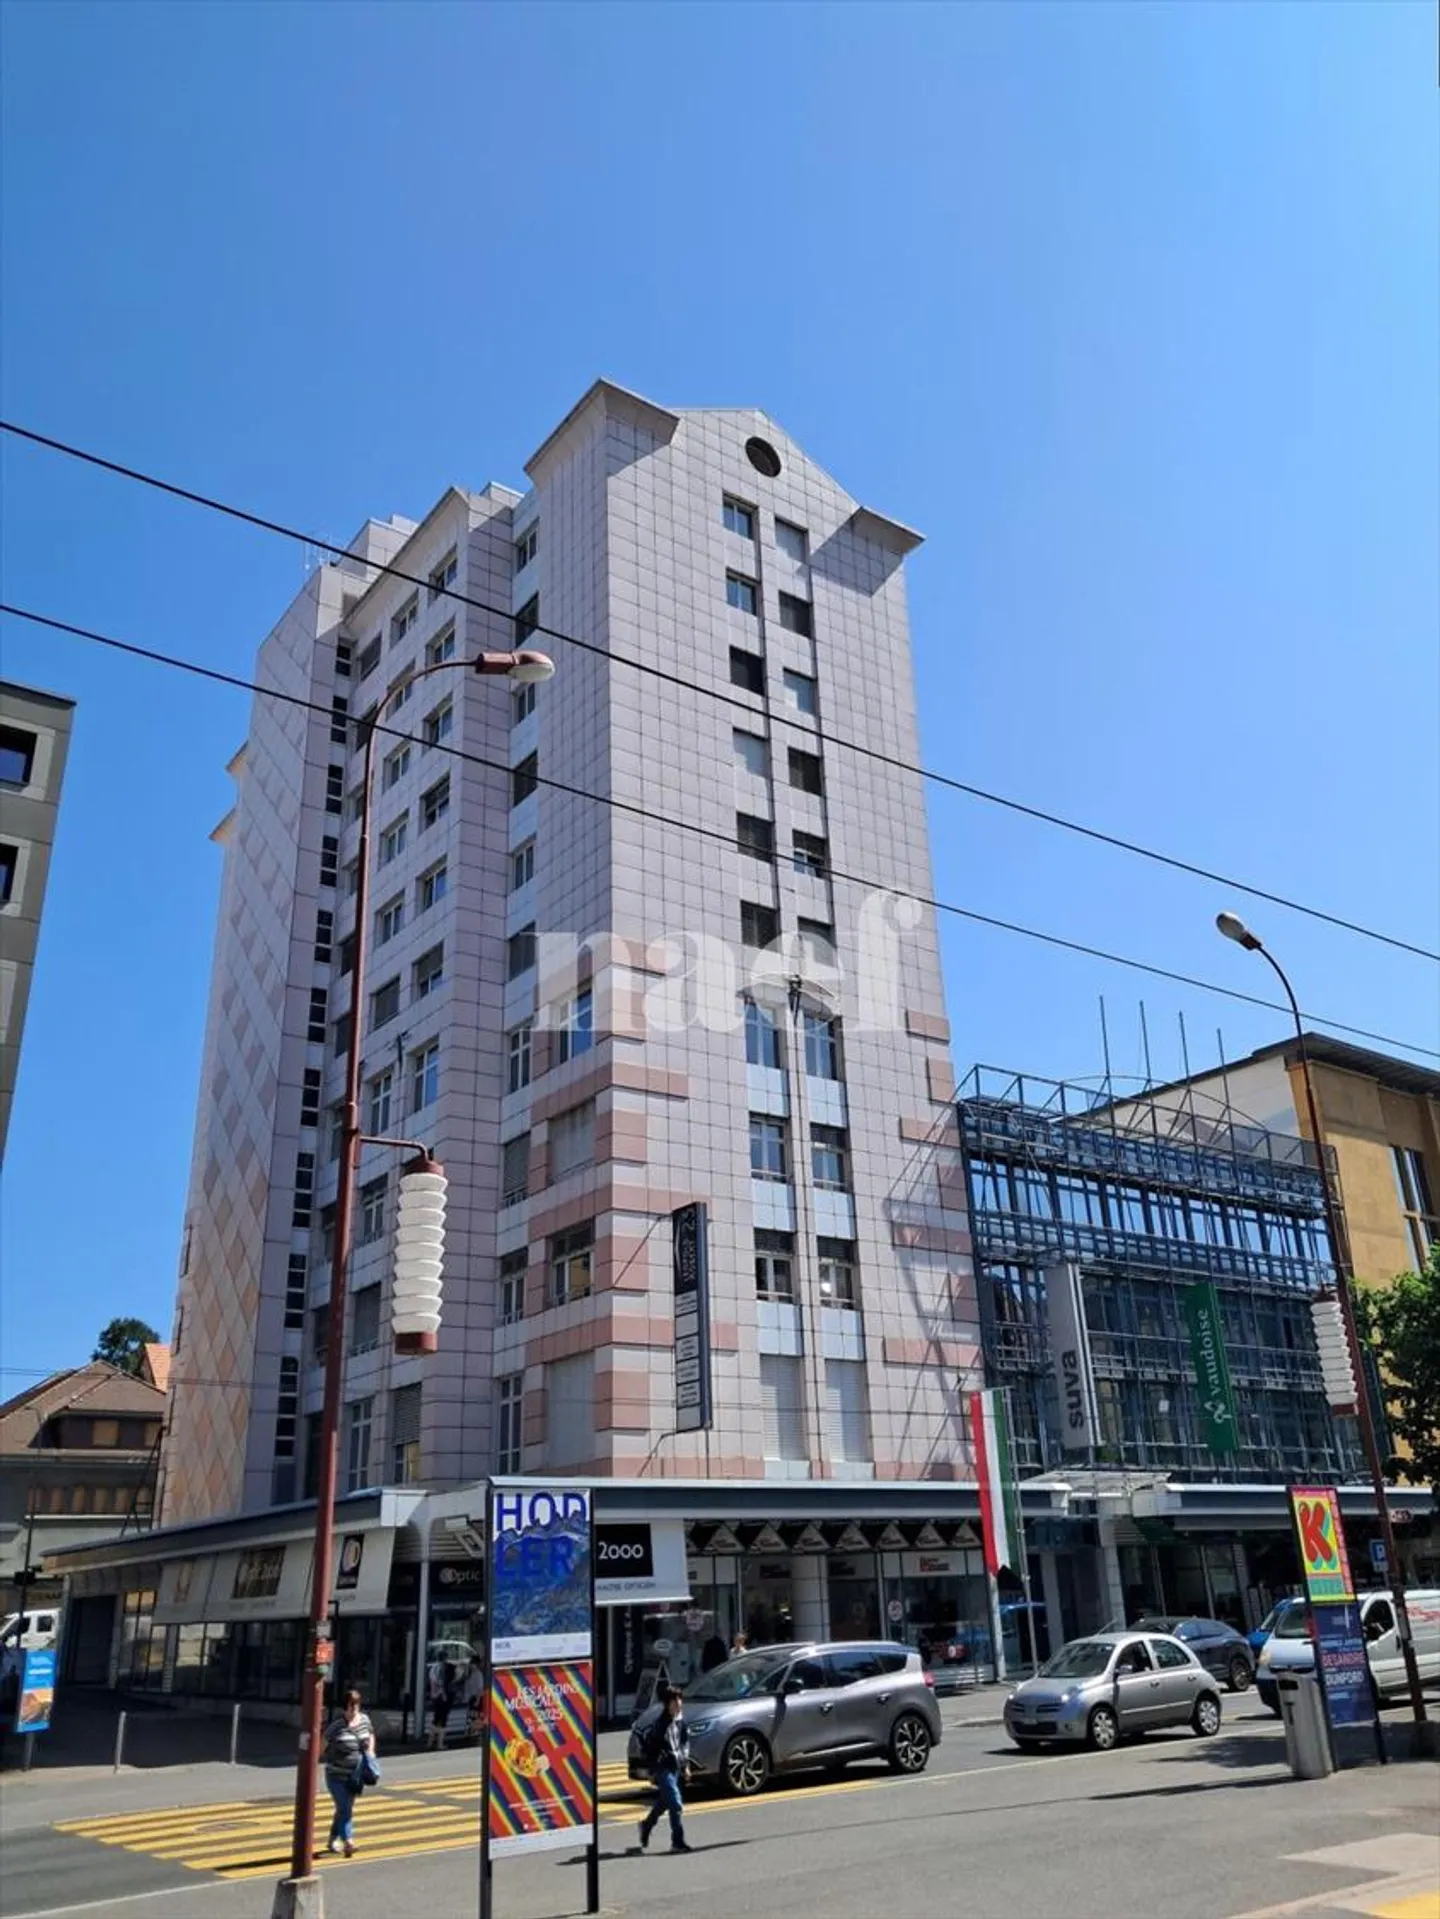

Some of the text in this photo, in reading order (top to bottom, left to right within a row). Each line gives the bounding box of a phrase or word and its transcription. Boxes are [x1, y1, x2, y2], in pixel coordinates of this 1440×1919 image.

[1198, 1309, 1221, 1397] vaudoise
[1062, 1350, 1084, 1428] suva
[497, 1492, 587, 1531] HOD
[1300, 1501, 1332, 1563] K
[496, 1536, 574, 1577] LER
[598, 1541, 644, 1560] 2000
